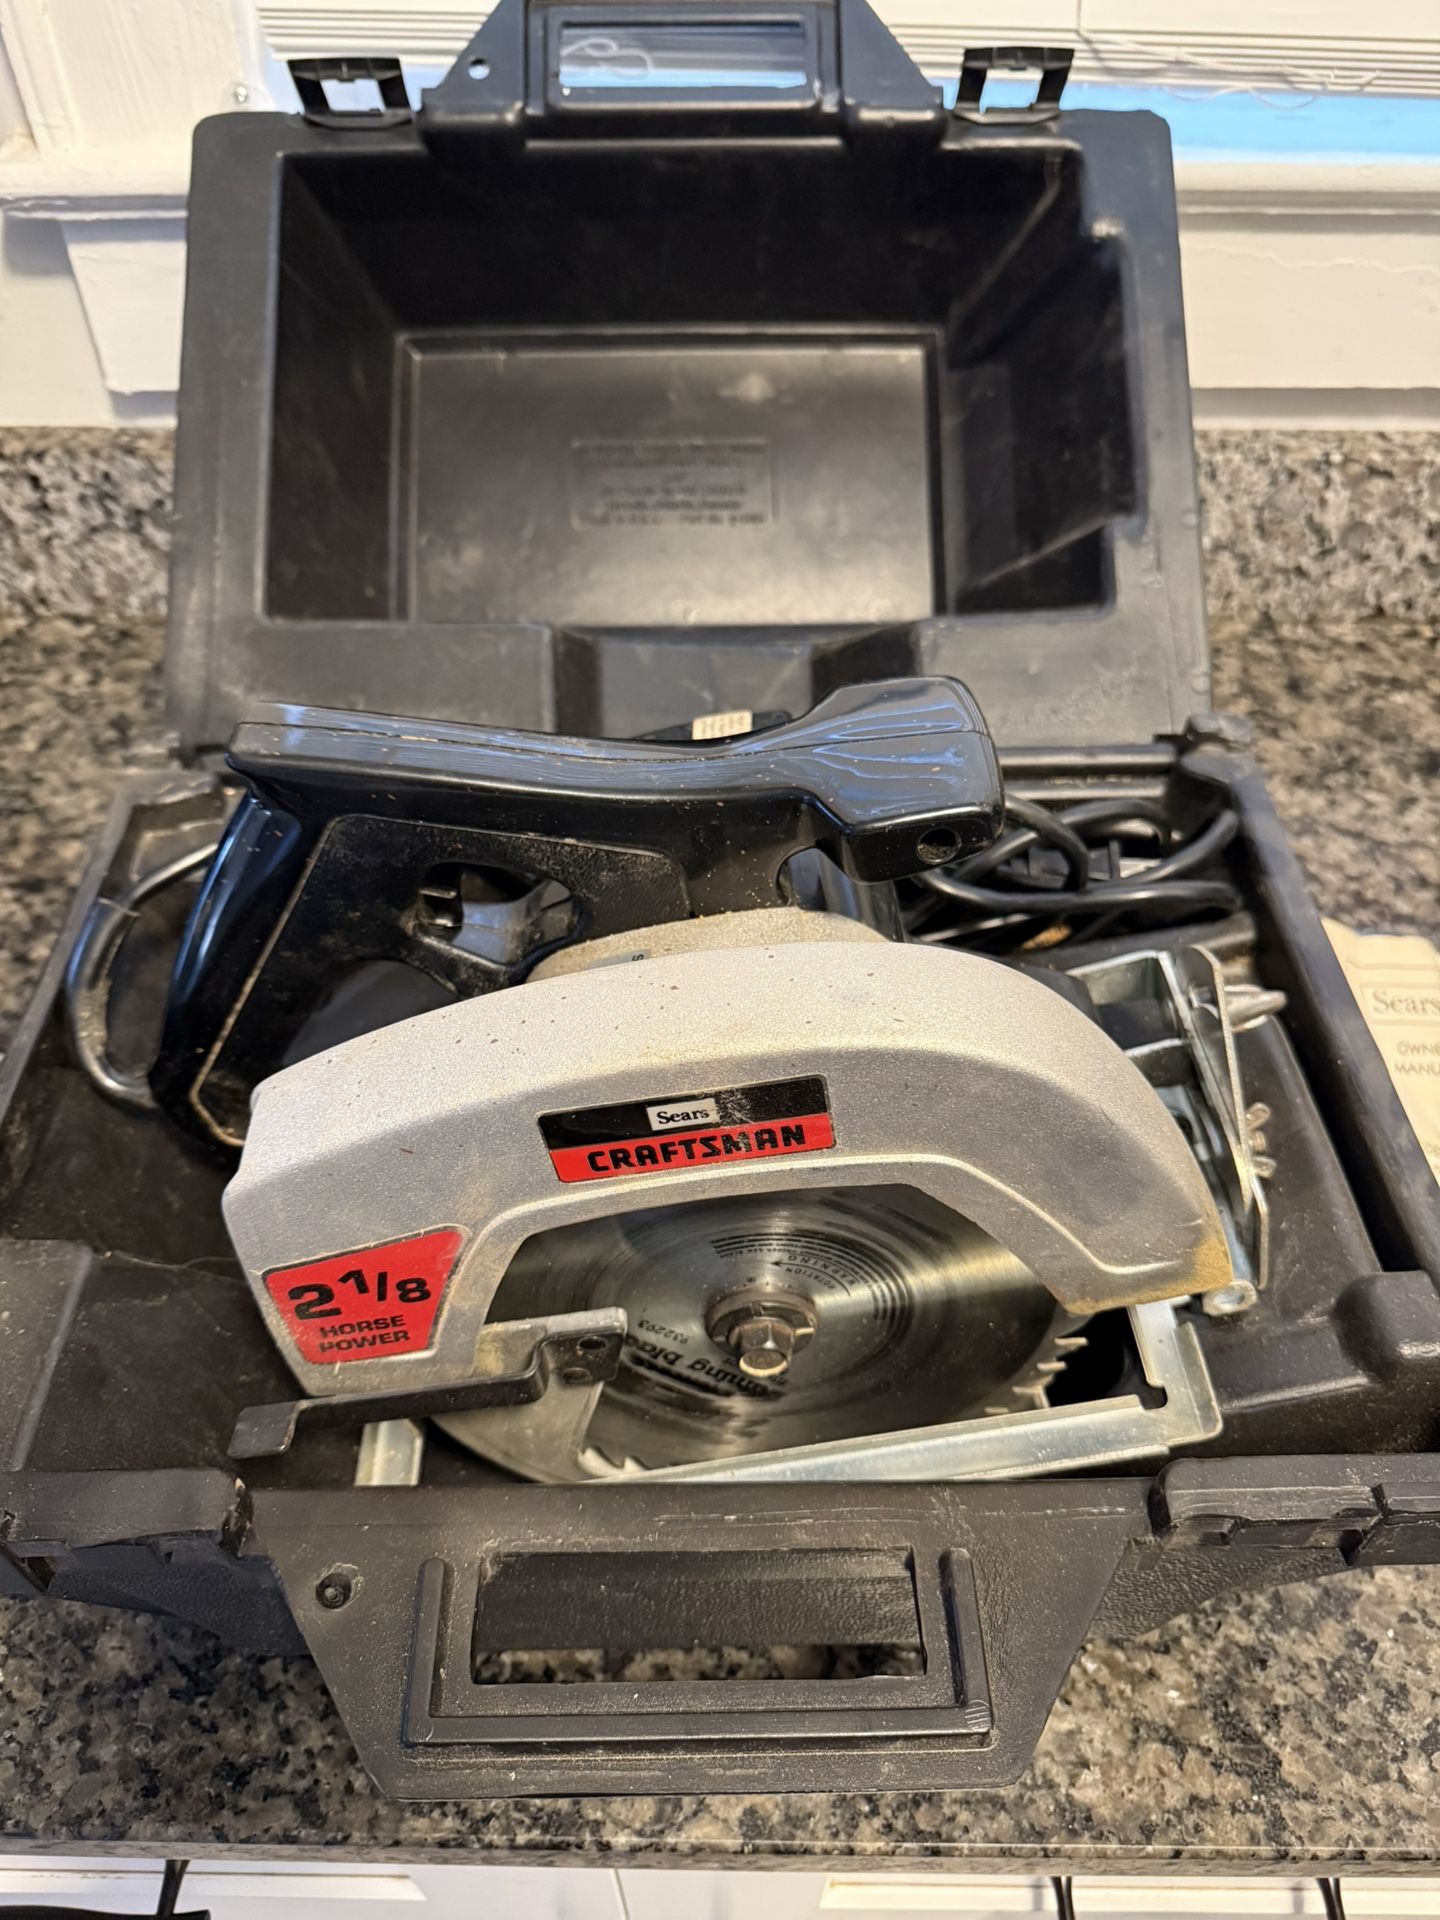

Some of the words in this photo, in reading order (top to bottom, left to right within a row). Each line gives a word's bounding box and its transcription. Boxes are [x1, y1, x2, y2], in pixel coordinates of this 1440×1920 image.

[655, 1107, 711, 1125] Sears
[586, 1124, 806, 1173] CRAFTSMAN
[787, 1254, 857, 1286] WARNING
[319, 1314, 406, 1339] HORSE
[319, 1330, 410, 1352] POWER
